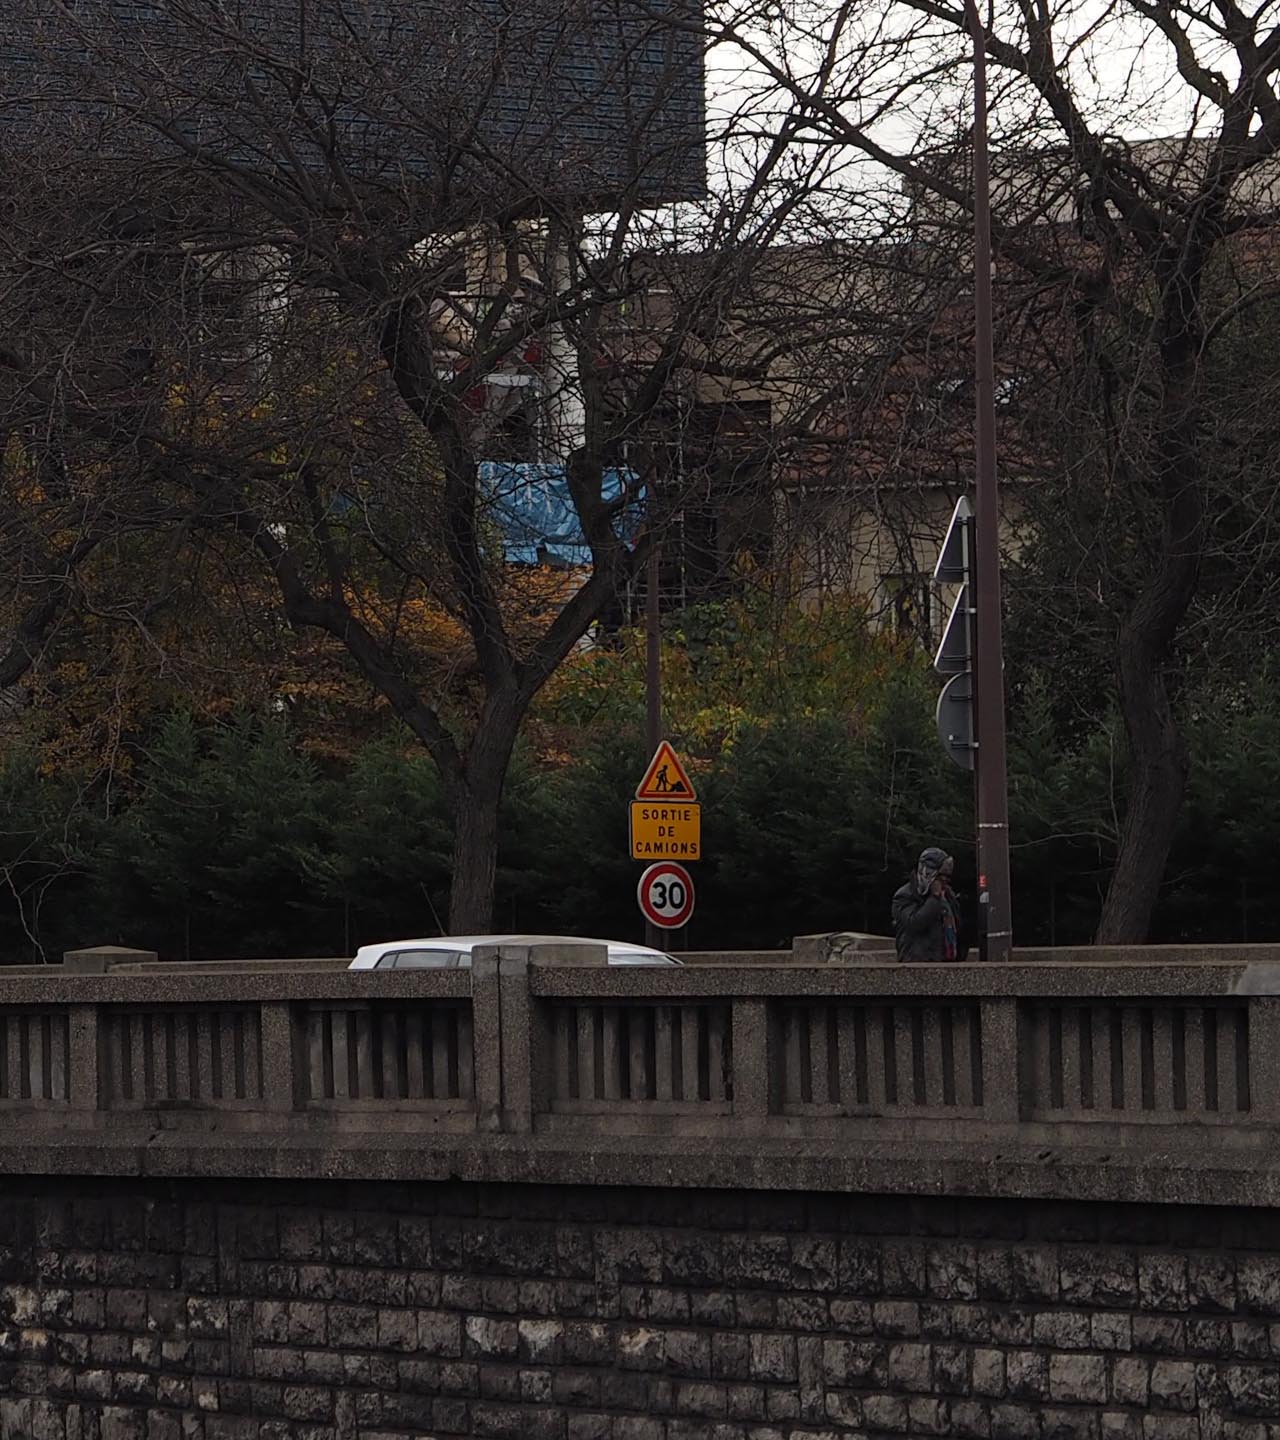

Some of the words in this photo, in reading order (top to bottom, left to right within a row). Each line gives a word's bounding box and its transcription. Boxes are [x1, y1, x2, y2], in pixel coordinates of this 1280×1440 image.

[642, 809, 691, 821] SORTIE
[658, 826, 675, 837] DE
[635, 842, 697, 854] CAMIONS
[652, 881, 685, 909] 30
